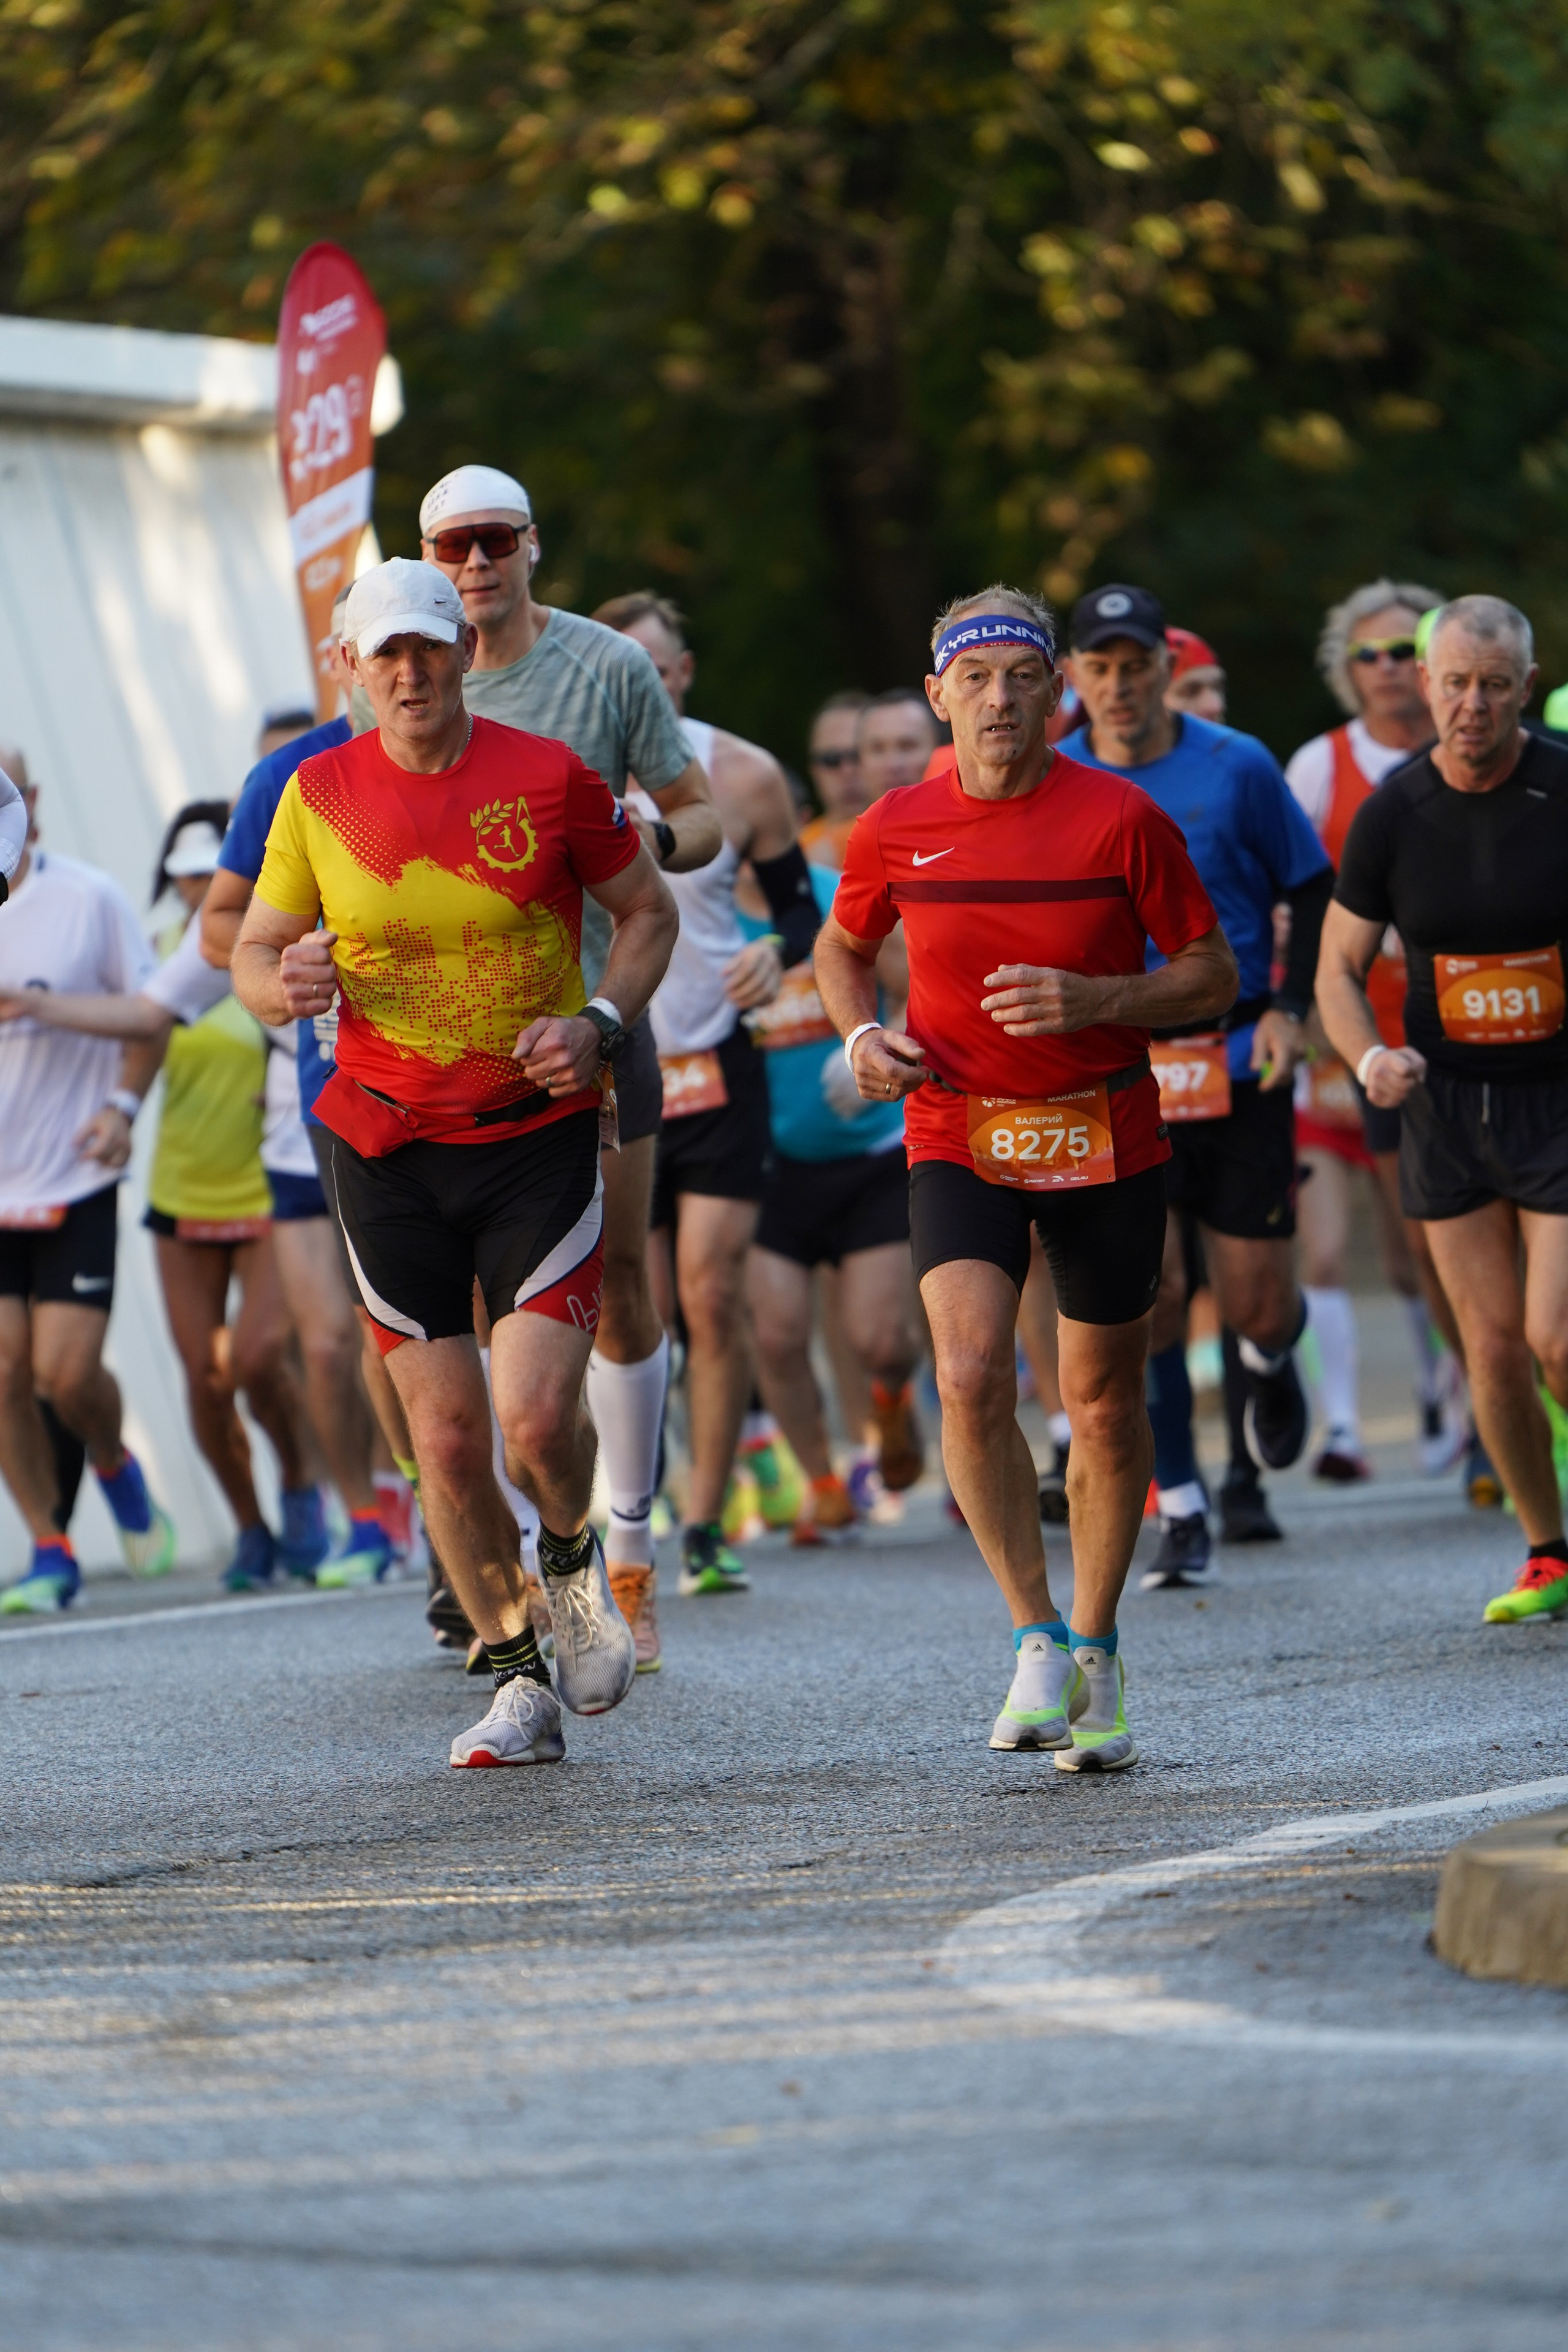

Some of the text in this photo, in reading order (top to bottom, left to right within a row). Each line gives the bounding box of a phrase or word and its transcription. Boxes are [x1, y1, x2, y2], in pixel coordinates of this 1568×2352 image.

[935, 624, 1054, 672] SKYRUNNING
[1462, 986, 1542, 1019] 9131
[1047, 1090, 1096, 1102] MARATHON
[1015, 1114, 1063, 1125] ВАЛЕРИЙ
[990, 1126, 1090, 1161] 8275
